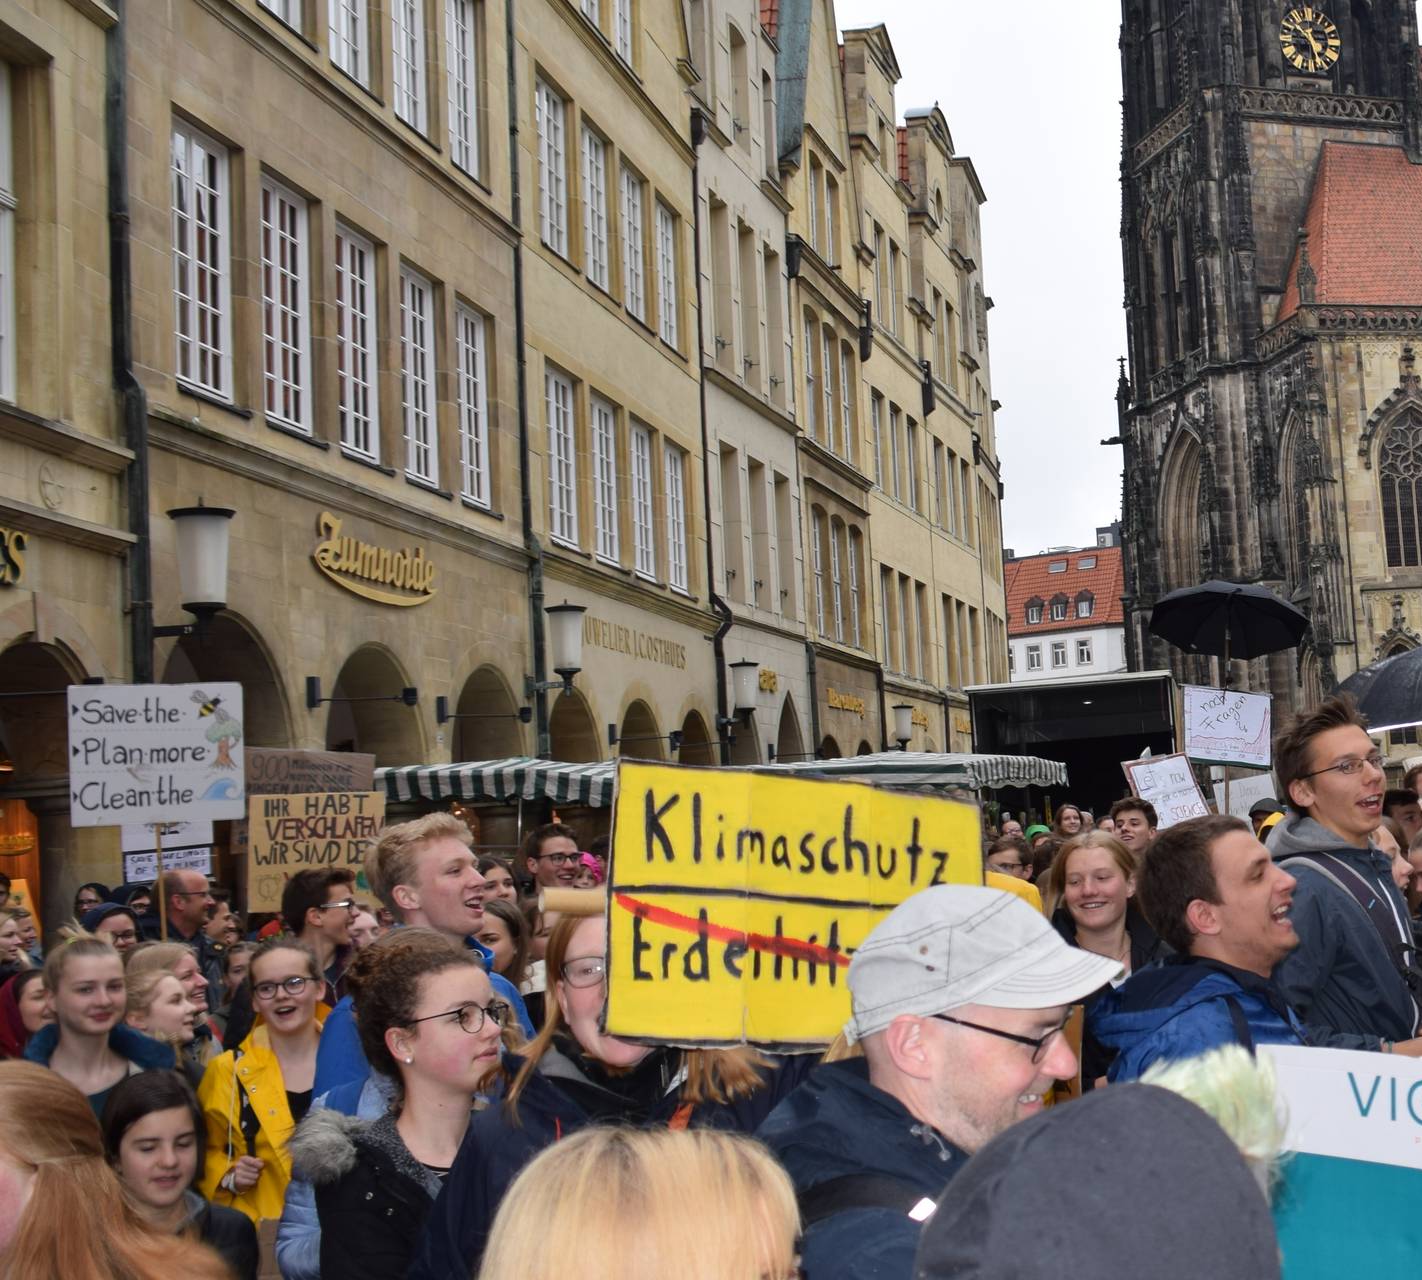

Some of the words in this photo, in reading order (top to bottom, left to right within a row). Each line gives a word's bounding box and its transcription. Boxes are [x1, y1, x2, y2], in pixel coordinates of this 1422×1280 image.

[314, 511, 438, 606] Zumnorde
[81, 700, 138, 725] Save
[150, 745, 206, 763] more
[79, 782, 151, 811] Clean
[264, 798, 290, 818] IHR
[304, 794, 369, 816] HABT
[645, 789, 949, 885] Klimaschutz
